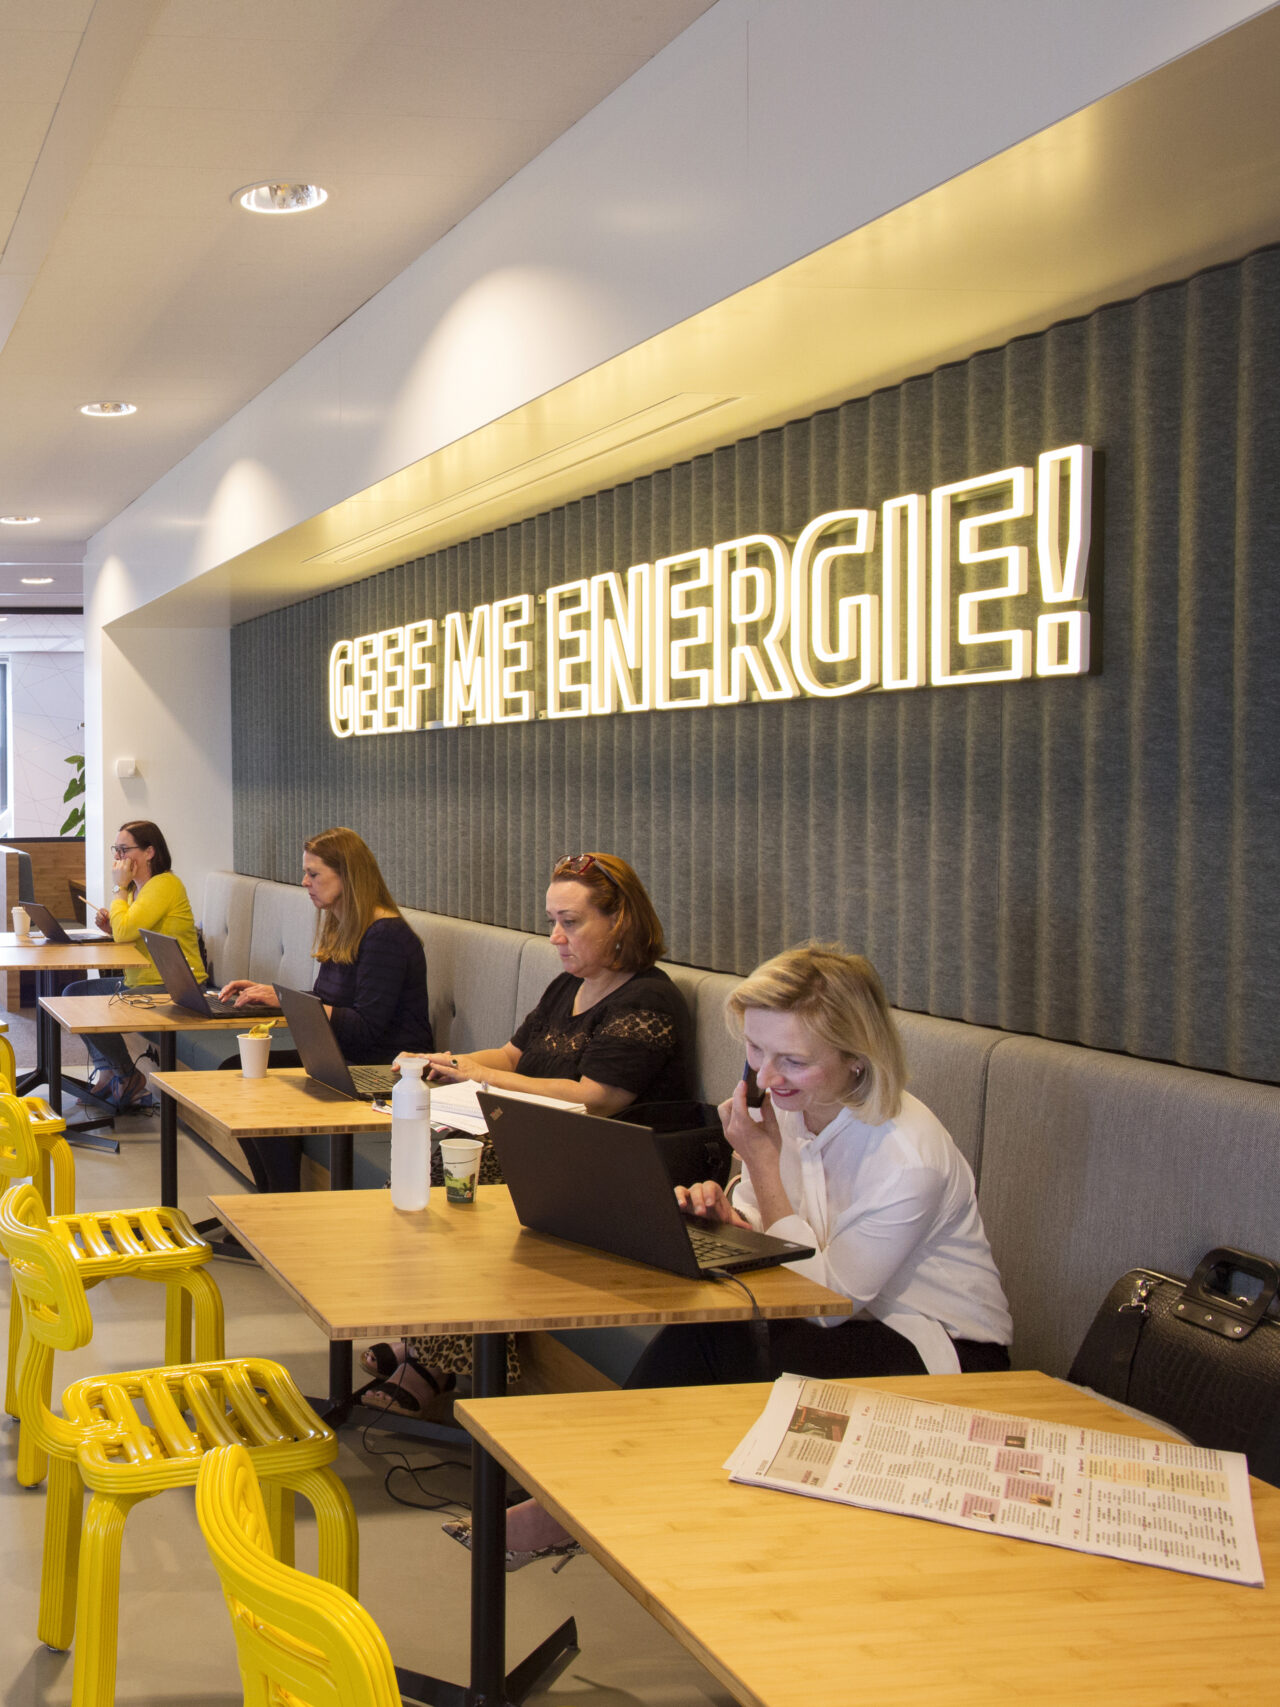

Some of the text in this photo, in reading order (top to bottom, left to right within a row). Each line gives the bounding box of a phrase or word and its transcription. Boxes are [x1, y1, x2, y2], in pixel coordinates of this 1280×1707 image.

[329, 444, 1093, 738] GEEF ME ENERGIE!
